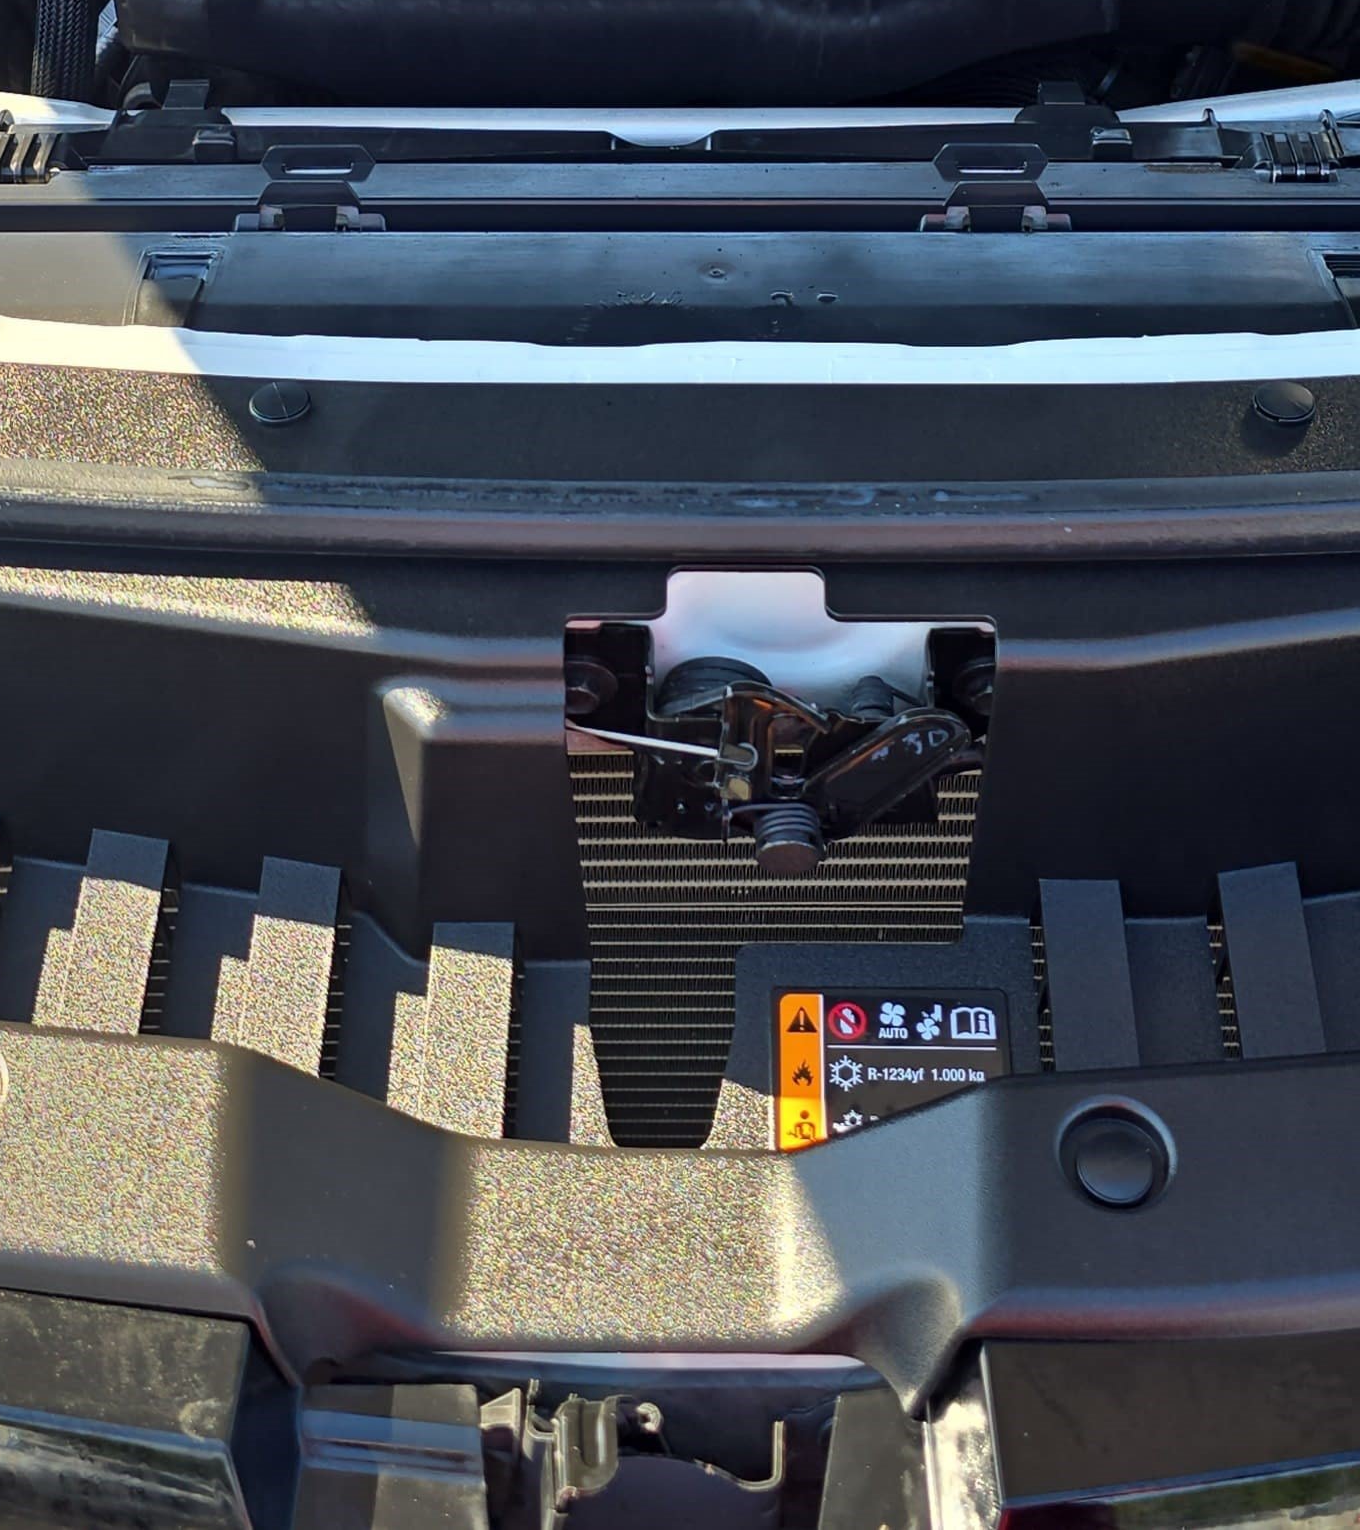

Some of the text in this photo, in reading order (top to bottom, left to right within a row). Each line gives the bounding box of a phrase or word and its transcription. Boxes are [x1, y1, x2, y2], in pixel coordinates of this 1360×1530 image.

[878, 1027, 909, 1039] AUTO
[867, 1067, 924, 1084] R-1234yf
[931, 1068, 966, 1082] 1.000
